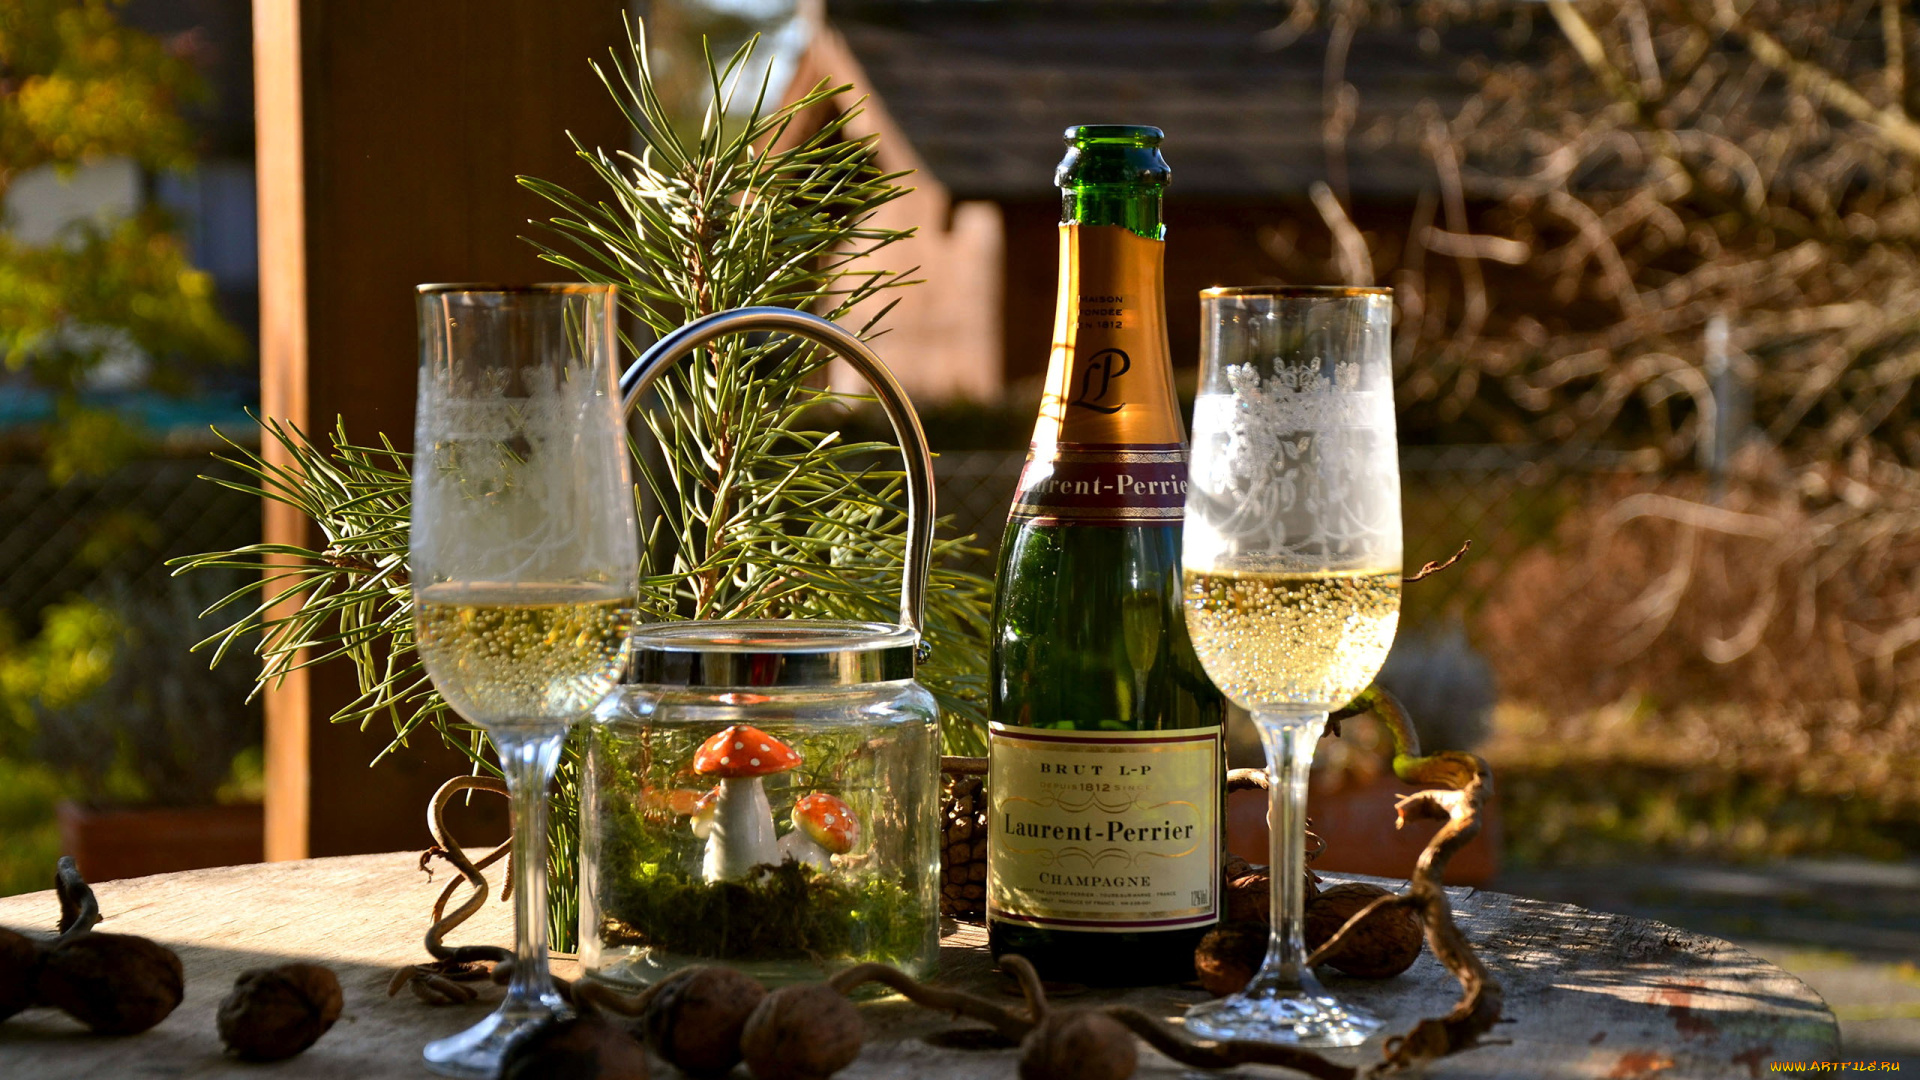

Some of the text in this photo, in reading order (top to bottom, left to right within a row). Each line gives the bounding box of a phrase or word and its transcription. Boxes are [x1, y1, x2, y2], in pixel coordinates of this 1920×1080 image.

[1077, 295, 1123, 303] MAISON
[1097, 321, 1123, 329] 1812
[1040, 762, 1152, 776] BRUT L-P
[1080, 783, 1111, 792] 1812
[1004, 812, 1194, 842] Laurent-Perrier
[1039, 872, 1151, 887] CHAMPAGNE
